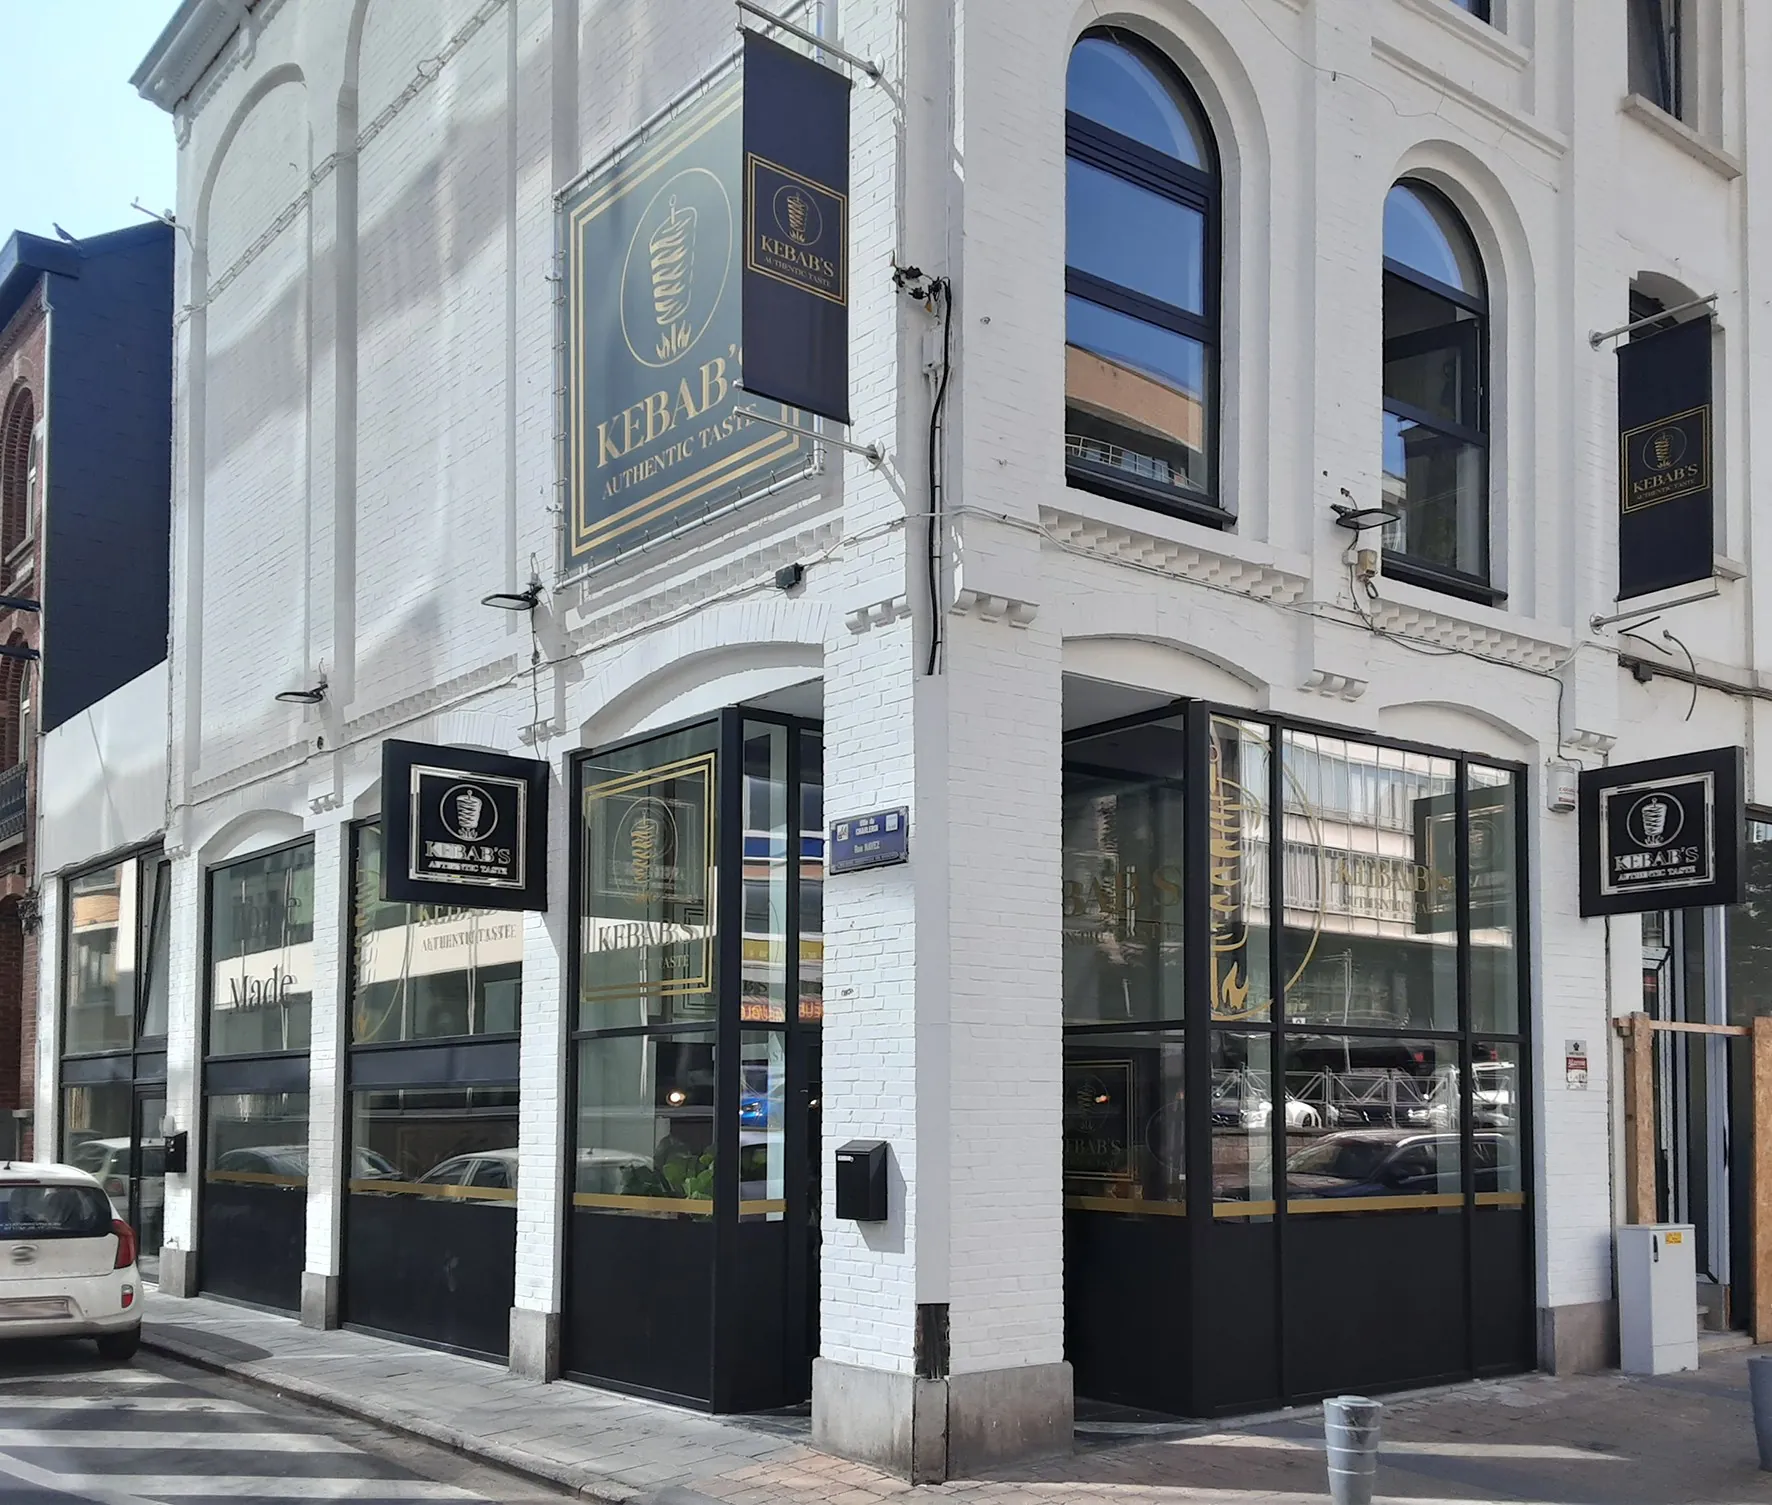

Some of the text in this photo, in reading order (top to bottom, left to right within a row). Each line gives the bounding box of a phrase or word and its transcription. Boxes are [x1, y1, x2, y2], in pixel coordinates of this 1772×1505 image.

[761, 234, 834, 278] KEBAB'S
[596, 343, 742, 469] KEBAB'
[602, 436, 695, 500] AUTHENTIC
[1633, 463, 1699, 493] KEBAB'S
[425, 840, 511, 865] KEBAB'S
[1613, 846, 1700, 872] KEBAB'S
[598, 917, 698, 951] KEBABS
[229, 964, 296, 1009] Made
